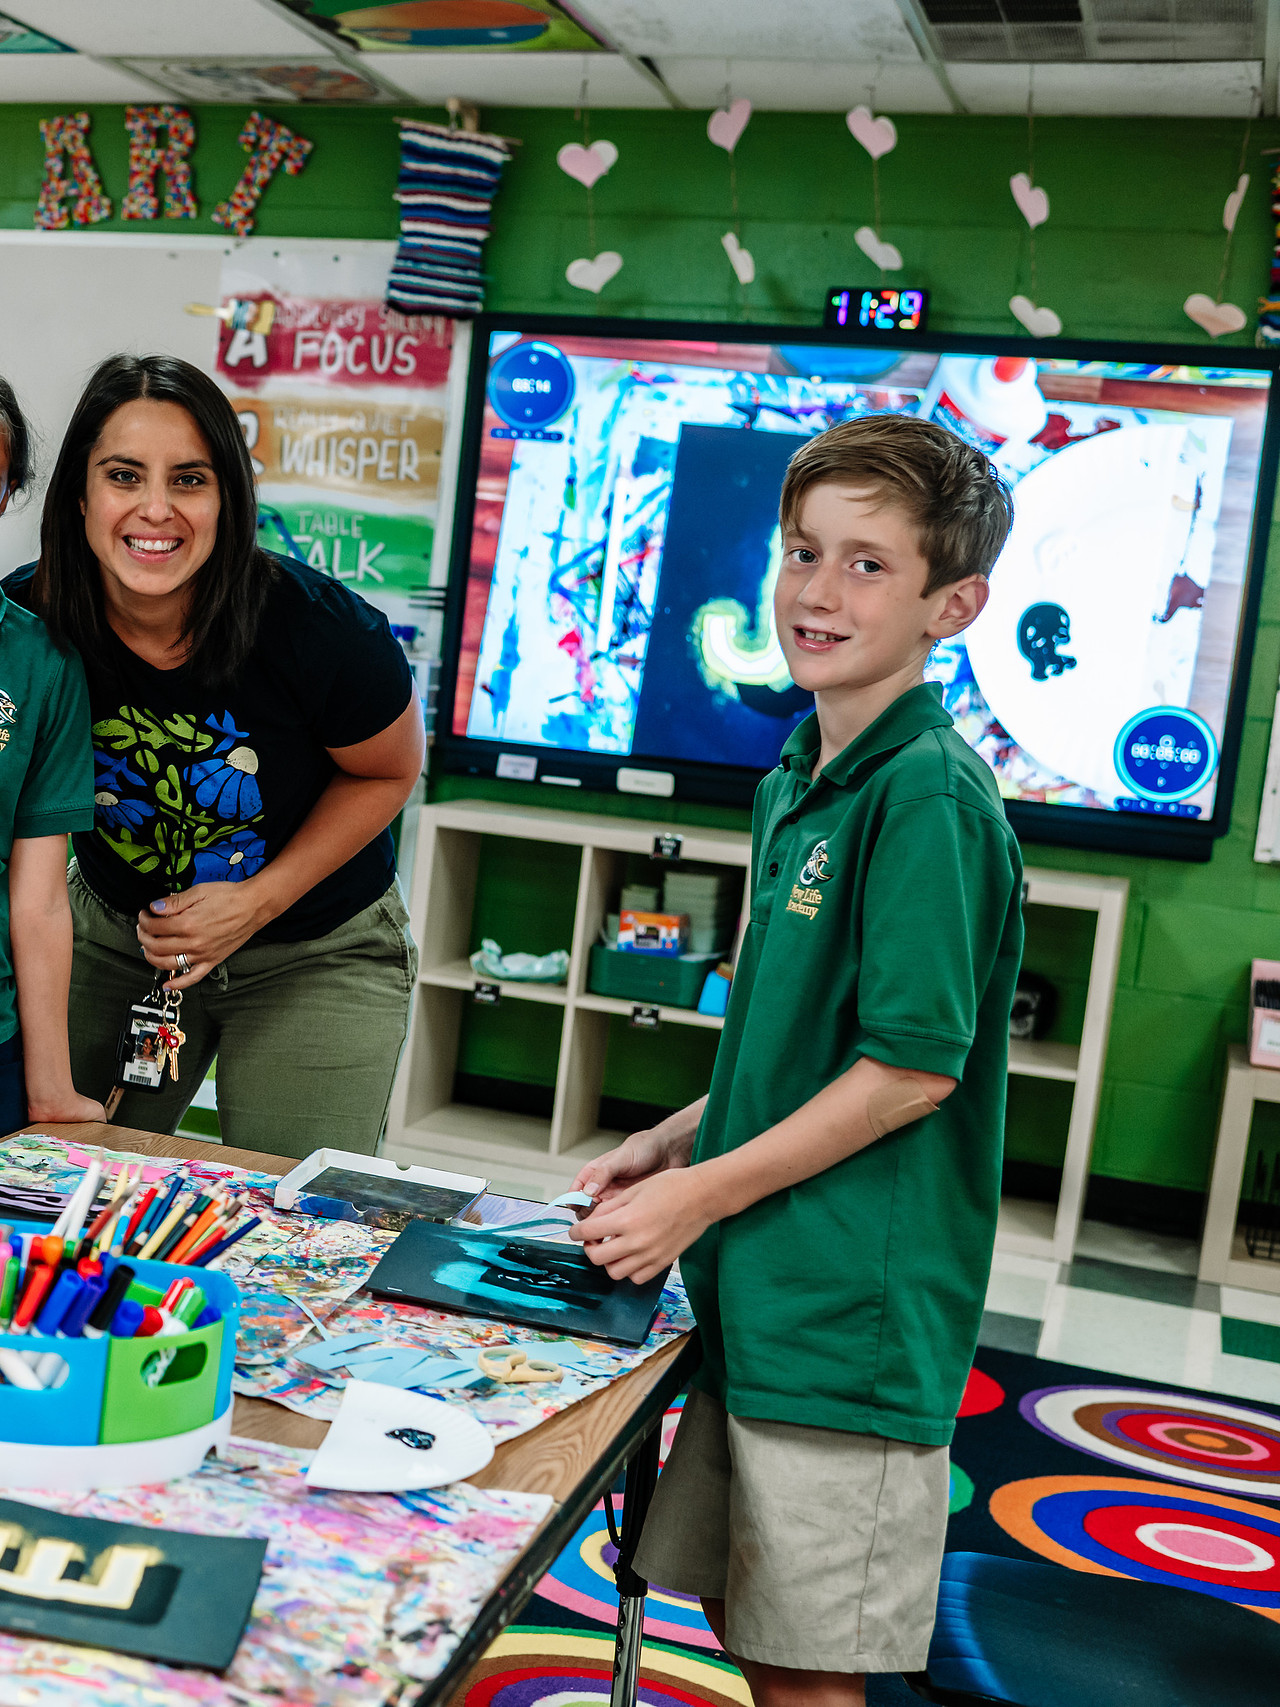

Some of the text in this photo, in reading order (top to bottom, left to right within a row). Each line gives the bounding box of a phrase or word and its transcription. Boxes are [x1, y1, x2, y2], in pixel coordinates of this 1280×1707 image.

[33, 103, 314, 238] ART
[831, 290, 924, 330] 11:29
[293, 330, 419, 376] FOCUS
[280, 435, 420, 482] WHISPER
[296, 509, 365, 539] TABLE
[802, 888, 823, 904] Life
